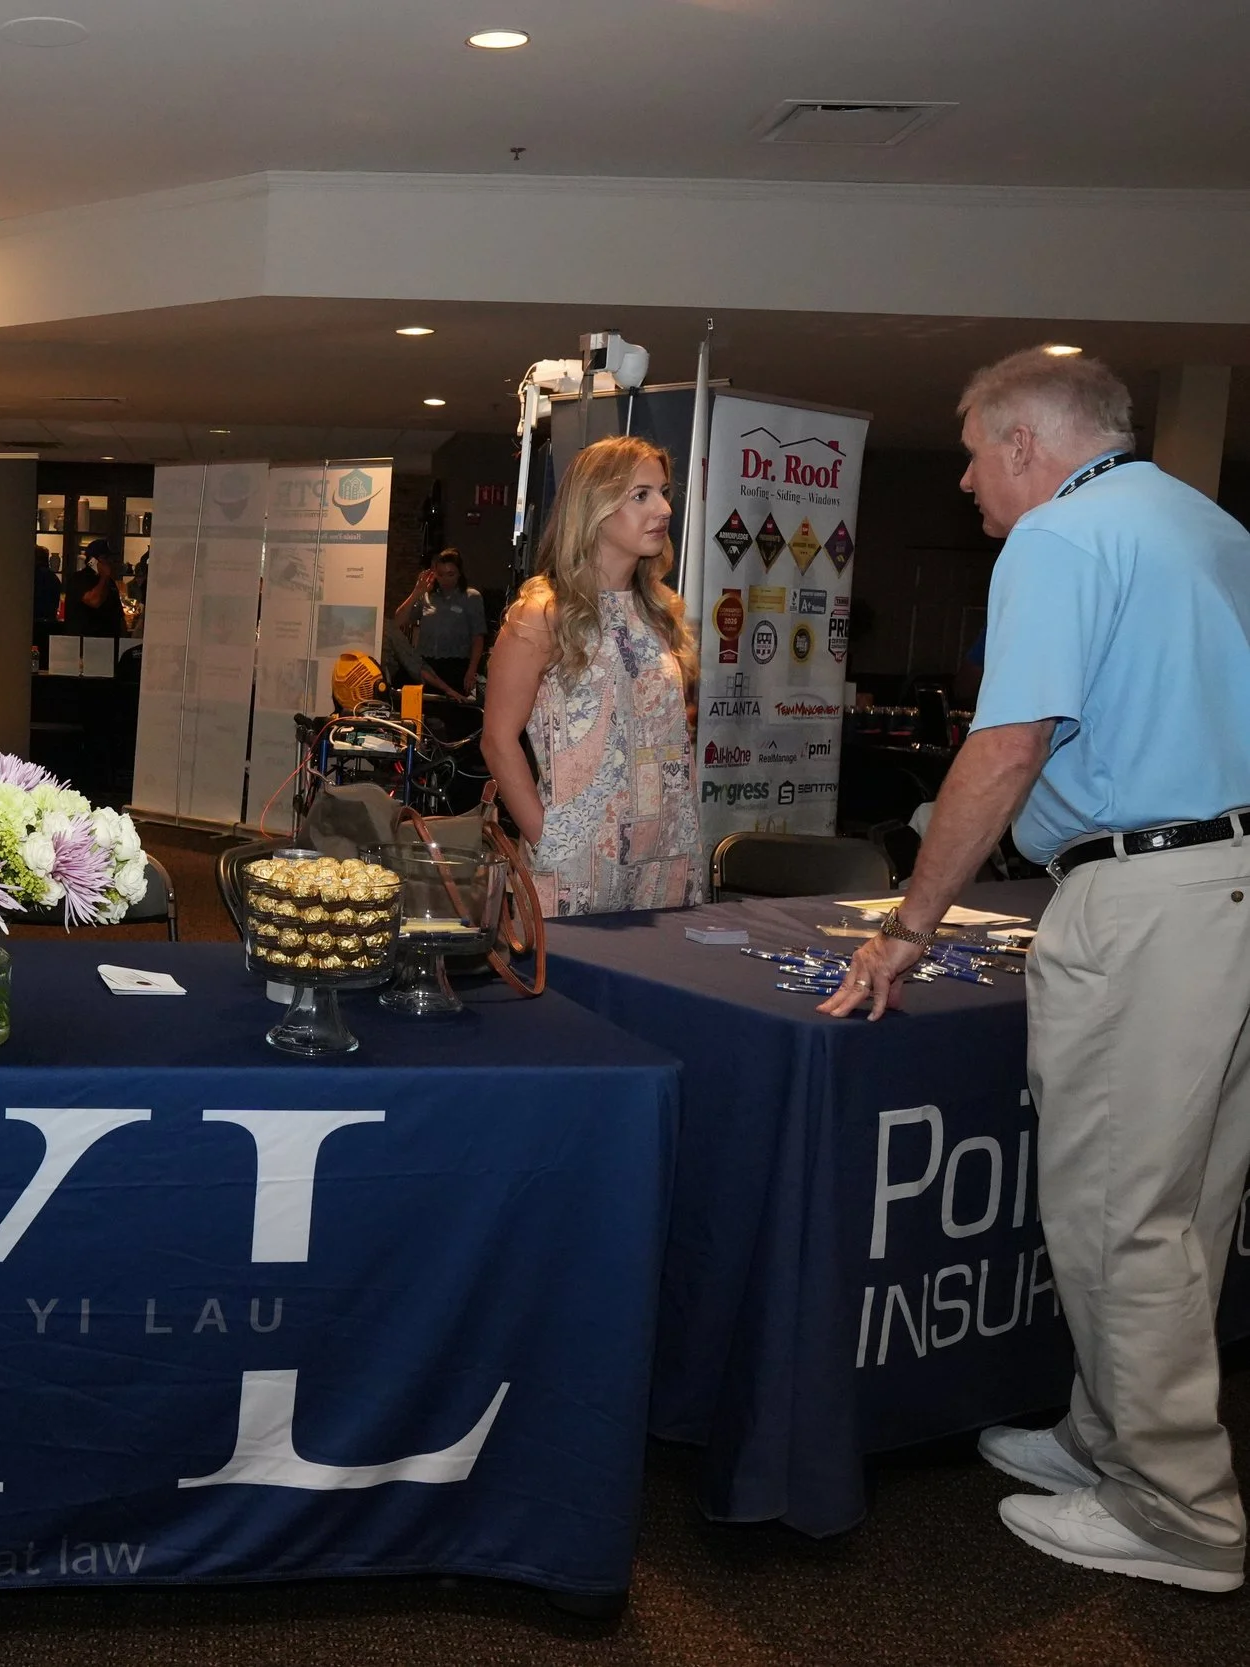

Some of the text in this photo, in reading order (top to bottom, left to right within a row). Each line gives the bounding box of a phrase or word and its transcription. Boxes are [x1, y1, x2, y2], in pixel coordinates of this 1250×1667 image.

[740, 448, 843, 489] Dr. Roof
[740, 484, 770, 500] Roofing
[776, 489, 801, 505] Siding
[808, 493, 841, 507] Windows
[709, 700, 761, 717] ATLANTA
[758, 753, 797, 765] RealManage
[808, 739, 831, 760] pmi
[868, 1088, 1031, 1260] Poi
[25, 1297, 90, 1334] YI
[145, 1297, 284, 1334] LAU
[855, 1246, 1061, 1369] INSUR
[58, 1536, 146, 1576] law
